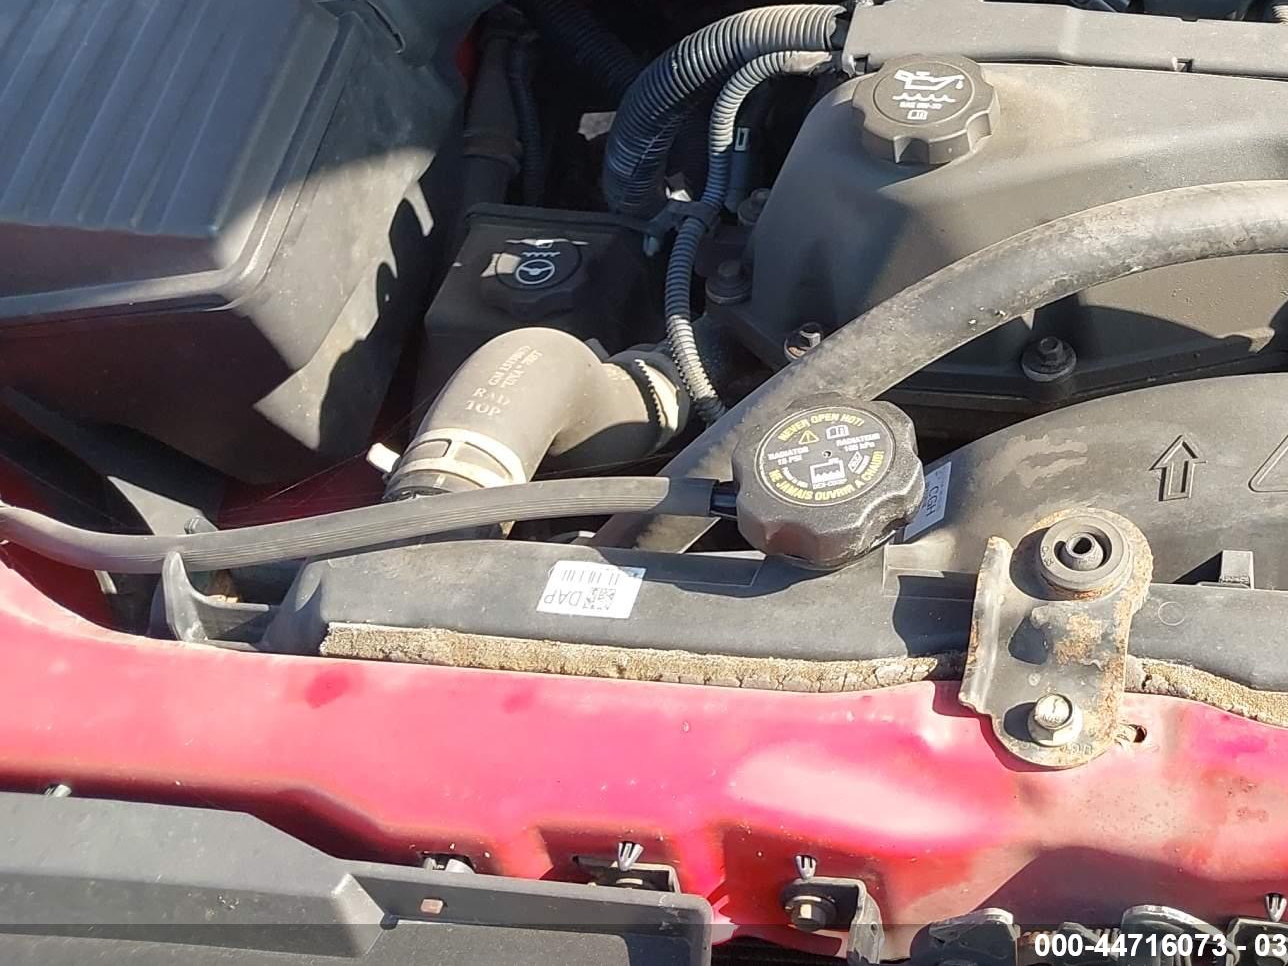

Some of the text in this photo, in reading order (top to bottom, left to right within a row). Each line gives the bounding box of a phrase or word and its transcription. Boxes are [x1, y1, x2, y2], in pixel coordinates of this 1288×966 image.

[465, 400, 502, 417] TOP
[473, 387, 511, 407] RAD
[777, 413, 865, 442] NEVER OPEN HOT!
[769, 469, 781, 483] NE
[776, 479, 813, 500] JAMAIS
[815, 483, 855, 501] OUVRIR
[926, 485, 940, 518] CGH
[543, 588, 583, 607] DAP
